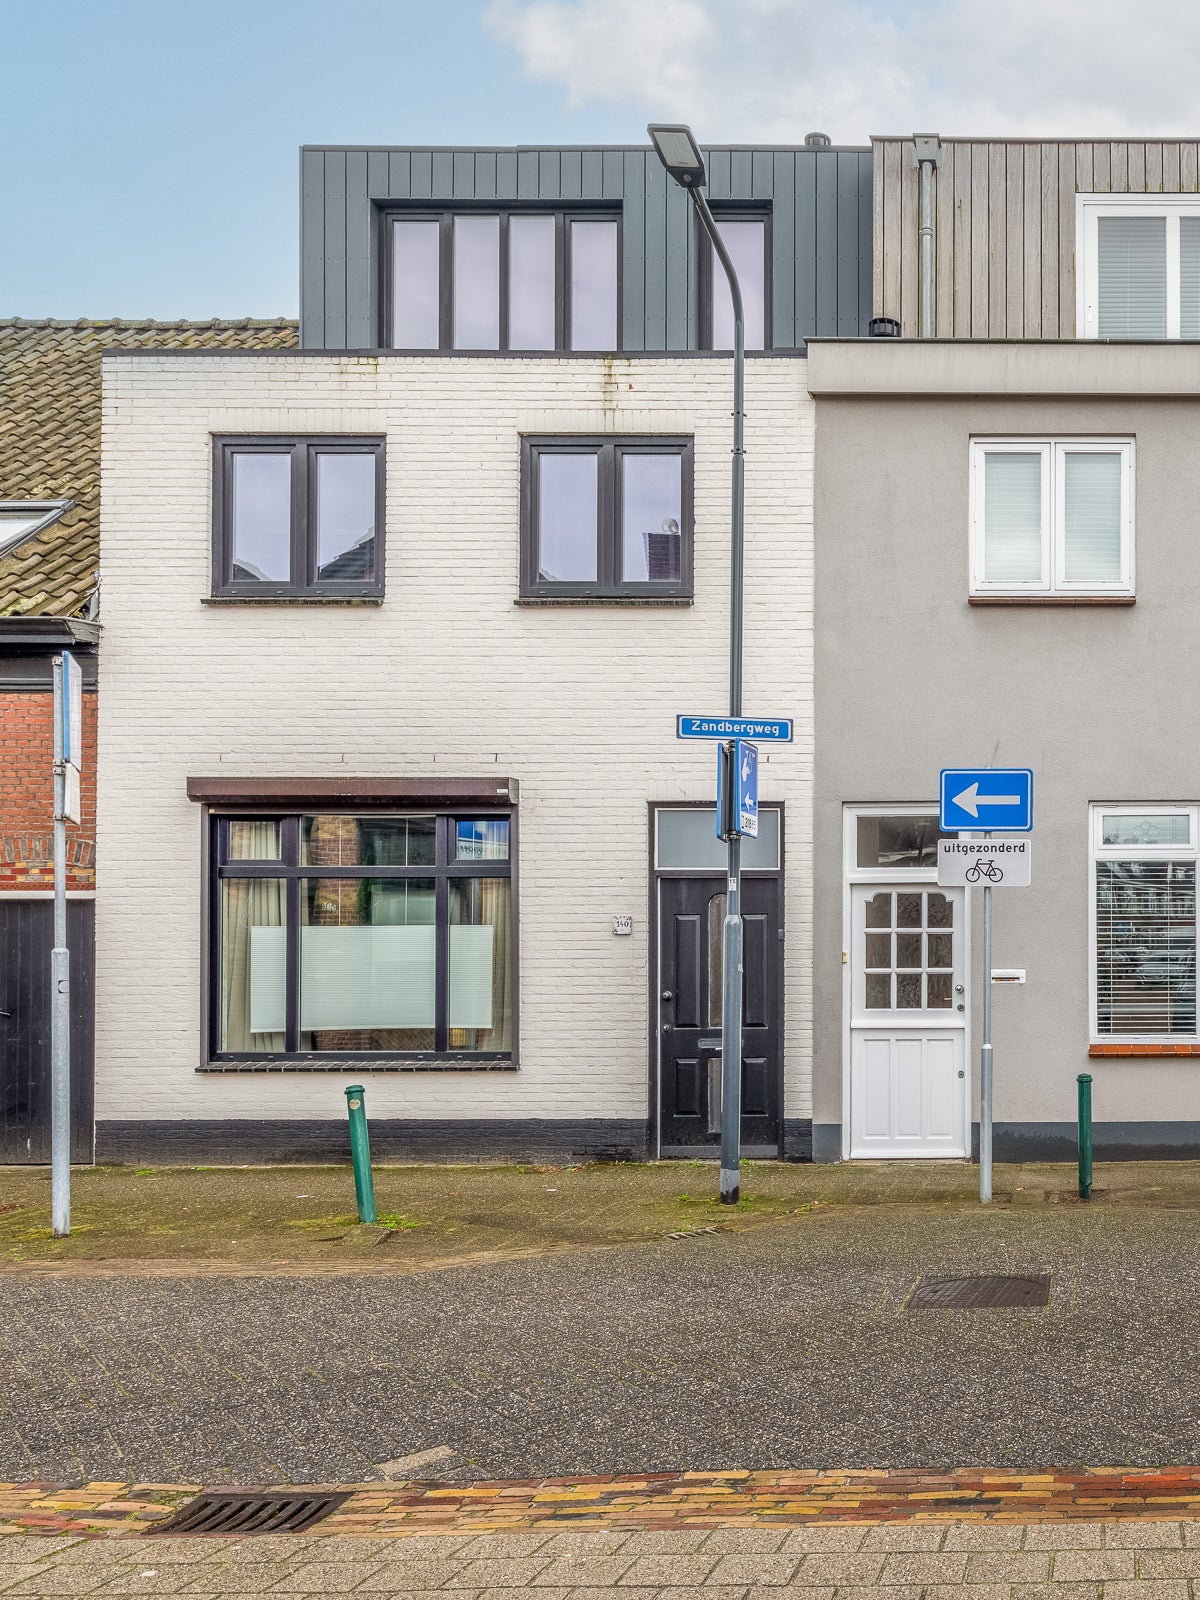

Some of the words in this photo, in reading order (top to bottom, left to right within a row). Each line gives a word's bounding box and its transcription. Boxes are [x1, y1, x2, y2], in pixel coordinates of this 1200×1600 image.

[691, 720, 780, 736] Zandbergweg
[944, 842, 1025, 855] uitgezonderd
[616, 920, 629, 928] 140
